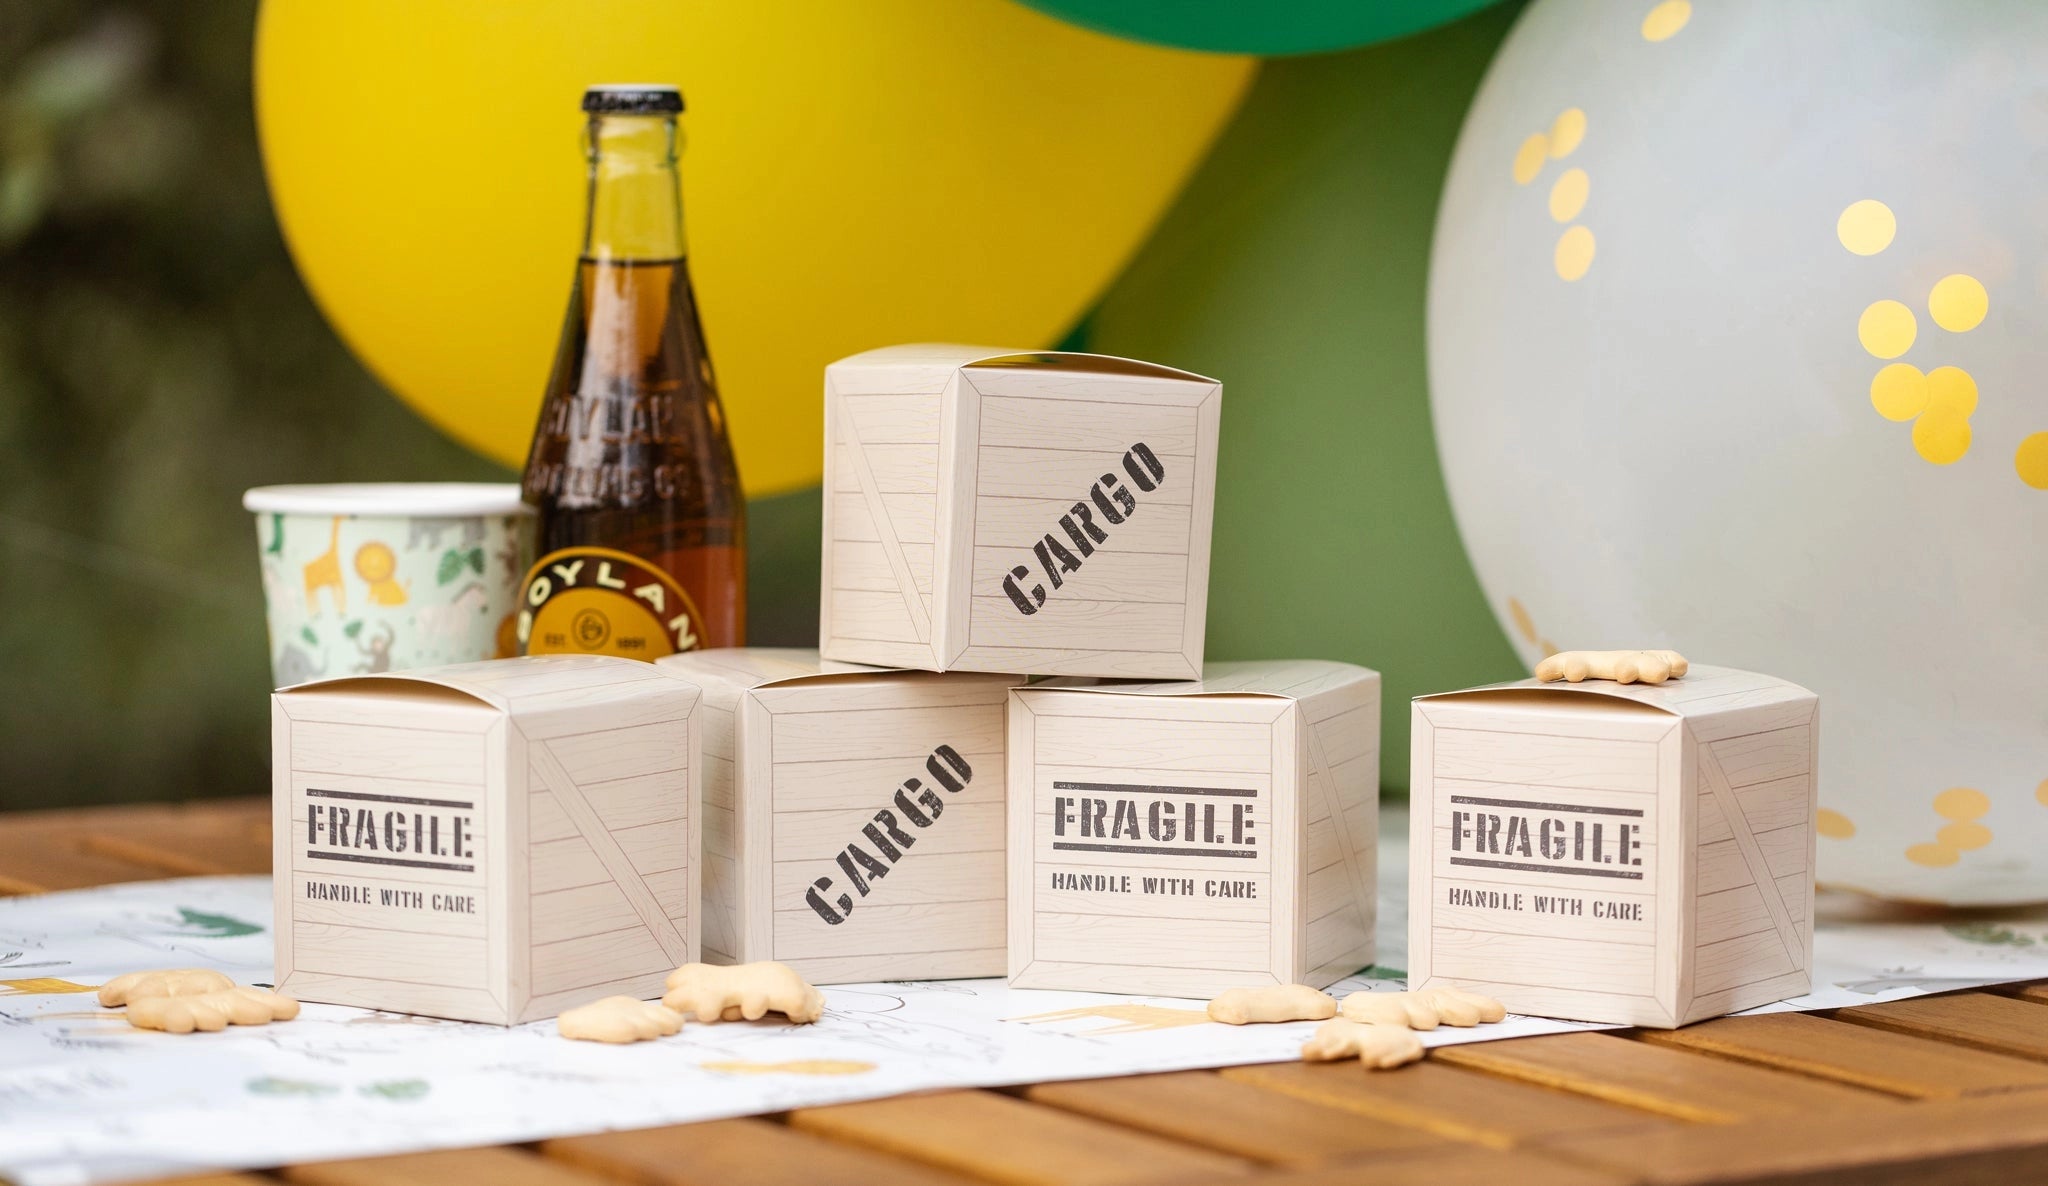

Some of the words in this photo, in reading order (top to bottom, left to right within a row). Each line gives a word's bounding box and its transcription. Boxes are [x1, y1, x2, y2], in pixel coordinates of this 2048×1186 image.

[1002, 442, 1165, 616] CARGO
[308, 804, 474, 859] FRAGILE
[805, 744, 973, 926] CARGO
[1054, 796, 1256, 845] FRAGILE
[1451, 810, 1643, 866] FRAGILE
[306, 881, 372, 905] HANDLE
[380, 888, 424, 910] WITH
[432, 893, 477, 915] CARE
[1052, 872, 1131, 893] HANDLE
[1143, 876, 1194, 896] WITH
[1204, 879, 1257, 899] CARE
[1449, 887, 1524, 911] HANDLE
[1534, 895, 1583, 917] WITH
[1593, 900, 1643, 922] CARE
